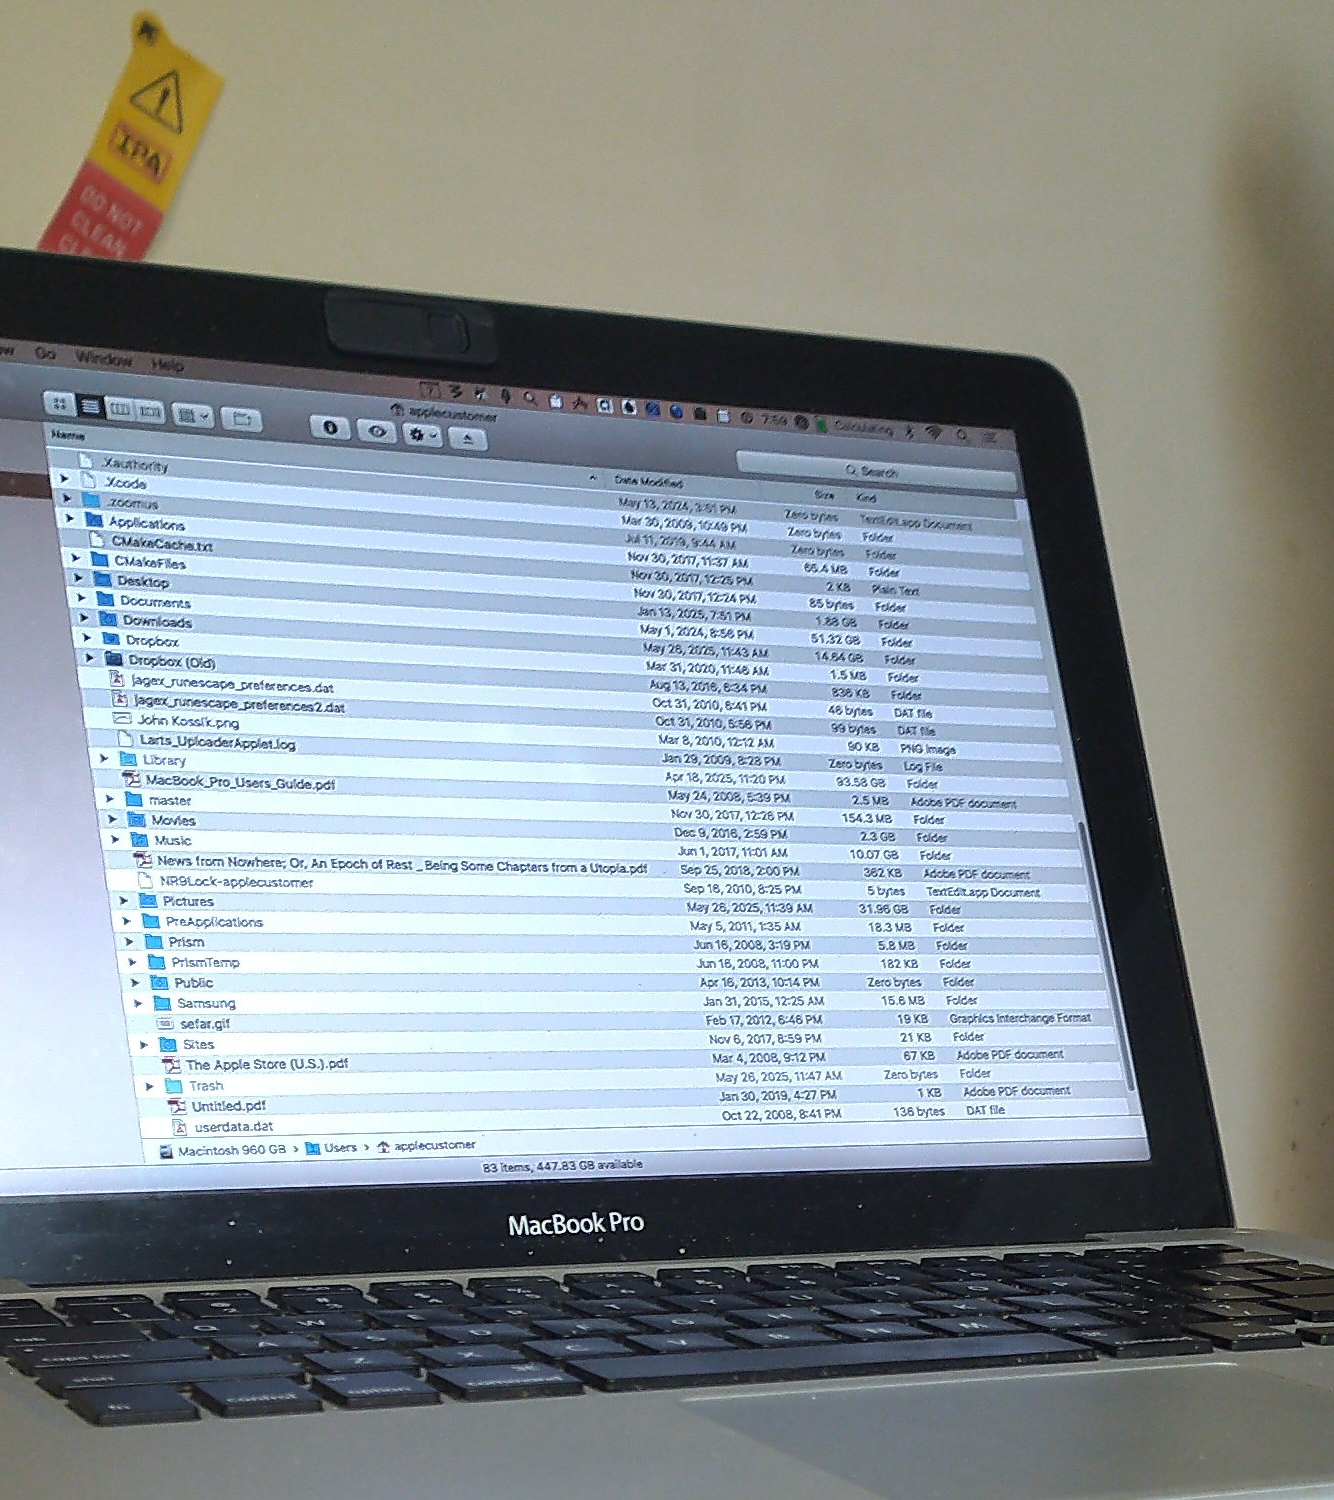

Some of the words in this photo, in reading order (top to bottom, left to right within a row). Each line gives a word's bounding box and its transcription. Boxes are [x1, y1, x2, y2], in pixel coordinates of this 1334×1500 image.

[116, 133, 161, 177] IPA
[33, 348, 57, 359] Go
[75, 352, 133, 367] Window
[150, 358, 185, 374] Help
[408, 406, 497, 424] applecustomer
[860, 466, 899, 479] Search
[613, 475, 639, 487] Date
[108, 516, 186, 533] Applications
[111, 536, 213, 552] CMakeCache.txt
[113, 556, 187, 570] CMakeFiles
[867, 566, 900, 578] Folder
[116, 575, 170, 591] Desktop
[119, 594, 192, 609] Documents
[122, 614, 193, 628] Downloads
[125, 634, 180, 650] Dropbox
[128, 654, 183, 669] Dropbox
[184, 657, 216, 670] (Old)
[136, 714, 169, 725] John
[142, 753, 186, 769] Library
[145, 775, 336, 792] MacBook_Pro_Users_Guide.pdf
[148, 794, 191, 806] master
[150, 814, 197, 826] Movies
[153, 834, 192, 846] Music
[156, 854, 193, 866] News
[194, 855, 225, 866] from
[310, 858, 328, 868] An
[329, 858, 369, 871] Epoch
[370, 859, 383, 869] of
[385, 859, 413, 870] Rest
[423, 860, 459, 873] Being
[459, 860, 494, 871] Some
[495, 861, 549, 875] Chapters
[550, 862, 578, 873] from
[579, 865, 588, 873] a
[588, 863, 648, 877] Utopia.pdf
[162, 895, 215, 907] Pictures
[165, 915, 264, 929] PreApplications
[167, 935, 205, 947] Prism
[171, 956, 240, 970] PrismTemp
[173, 977, 214, 987] Public
[177, 998, 237, 1011] Samsung
[948, 1013, 995, 1025] Graphics
[995, 1012, 1055, 1025] Interchange
[1055, 1012, 1092, 1023] Format
[182, 1039, 215, 1050] Sites
[955, 1049, 989, 1060] Adobe
[990, 1049, 1012, 1059] PDF
[1013, 1048, 1067, 1059] document
[185, 1059, 211, 1070] The
[213, 1059, 251, 1072] Apple
[252, 1058, 287, 1069] Store
[958, 1068, 991, 1079] Folder
[189, 1080, 224, 1090] Trash
[191, 1100, 266, 1113] Untitled.pdf
[194, 1120, 273, 1132] userdata.dat
[177, 1145, 240, 1157] Macintosh
[241, 1144, 266, 1155] 960
[267, 1143, 287, 1154] GB
[323, 1142, 358, 1152] Users
[393, 1139, 476, 1154] applecustomer
[482, 1162, 498, 1173] 83
[499, 1161, 534, 1174] items,
[577, 1160, 595, 1171] GB
[596, 1159, 643, 1170] available
[508, 1212, 607, 1236] MacBook
[608, 1211, 645, 1232] Pro
